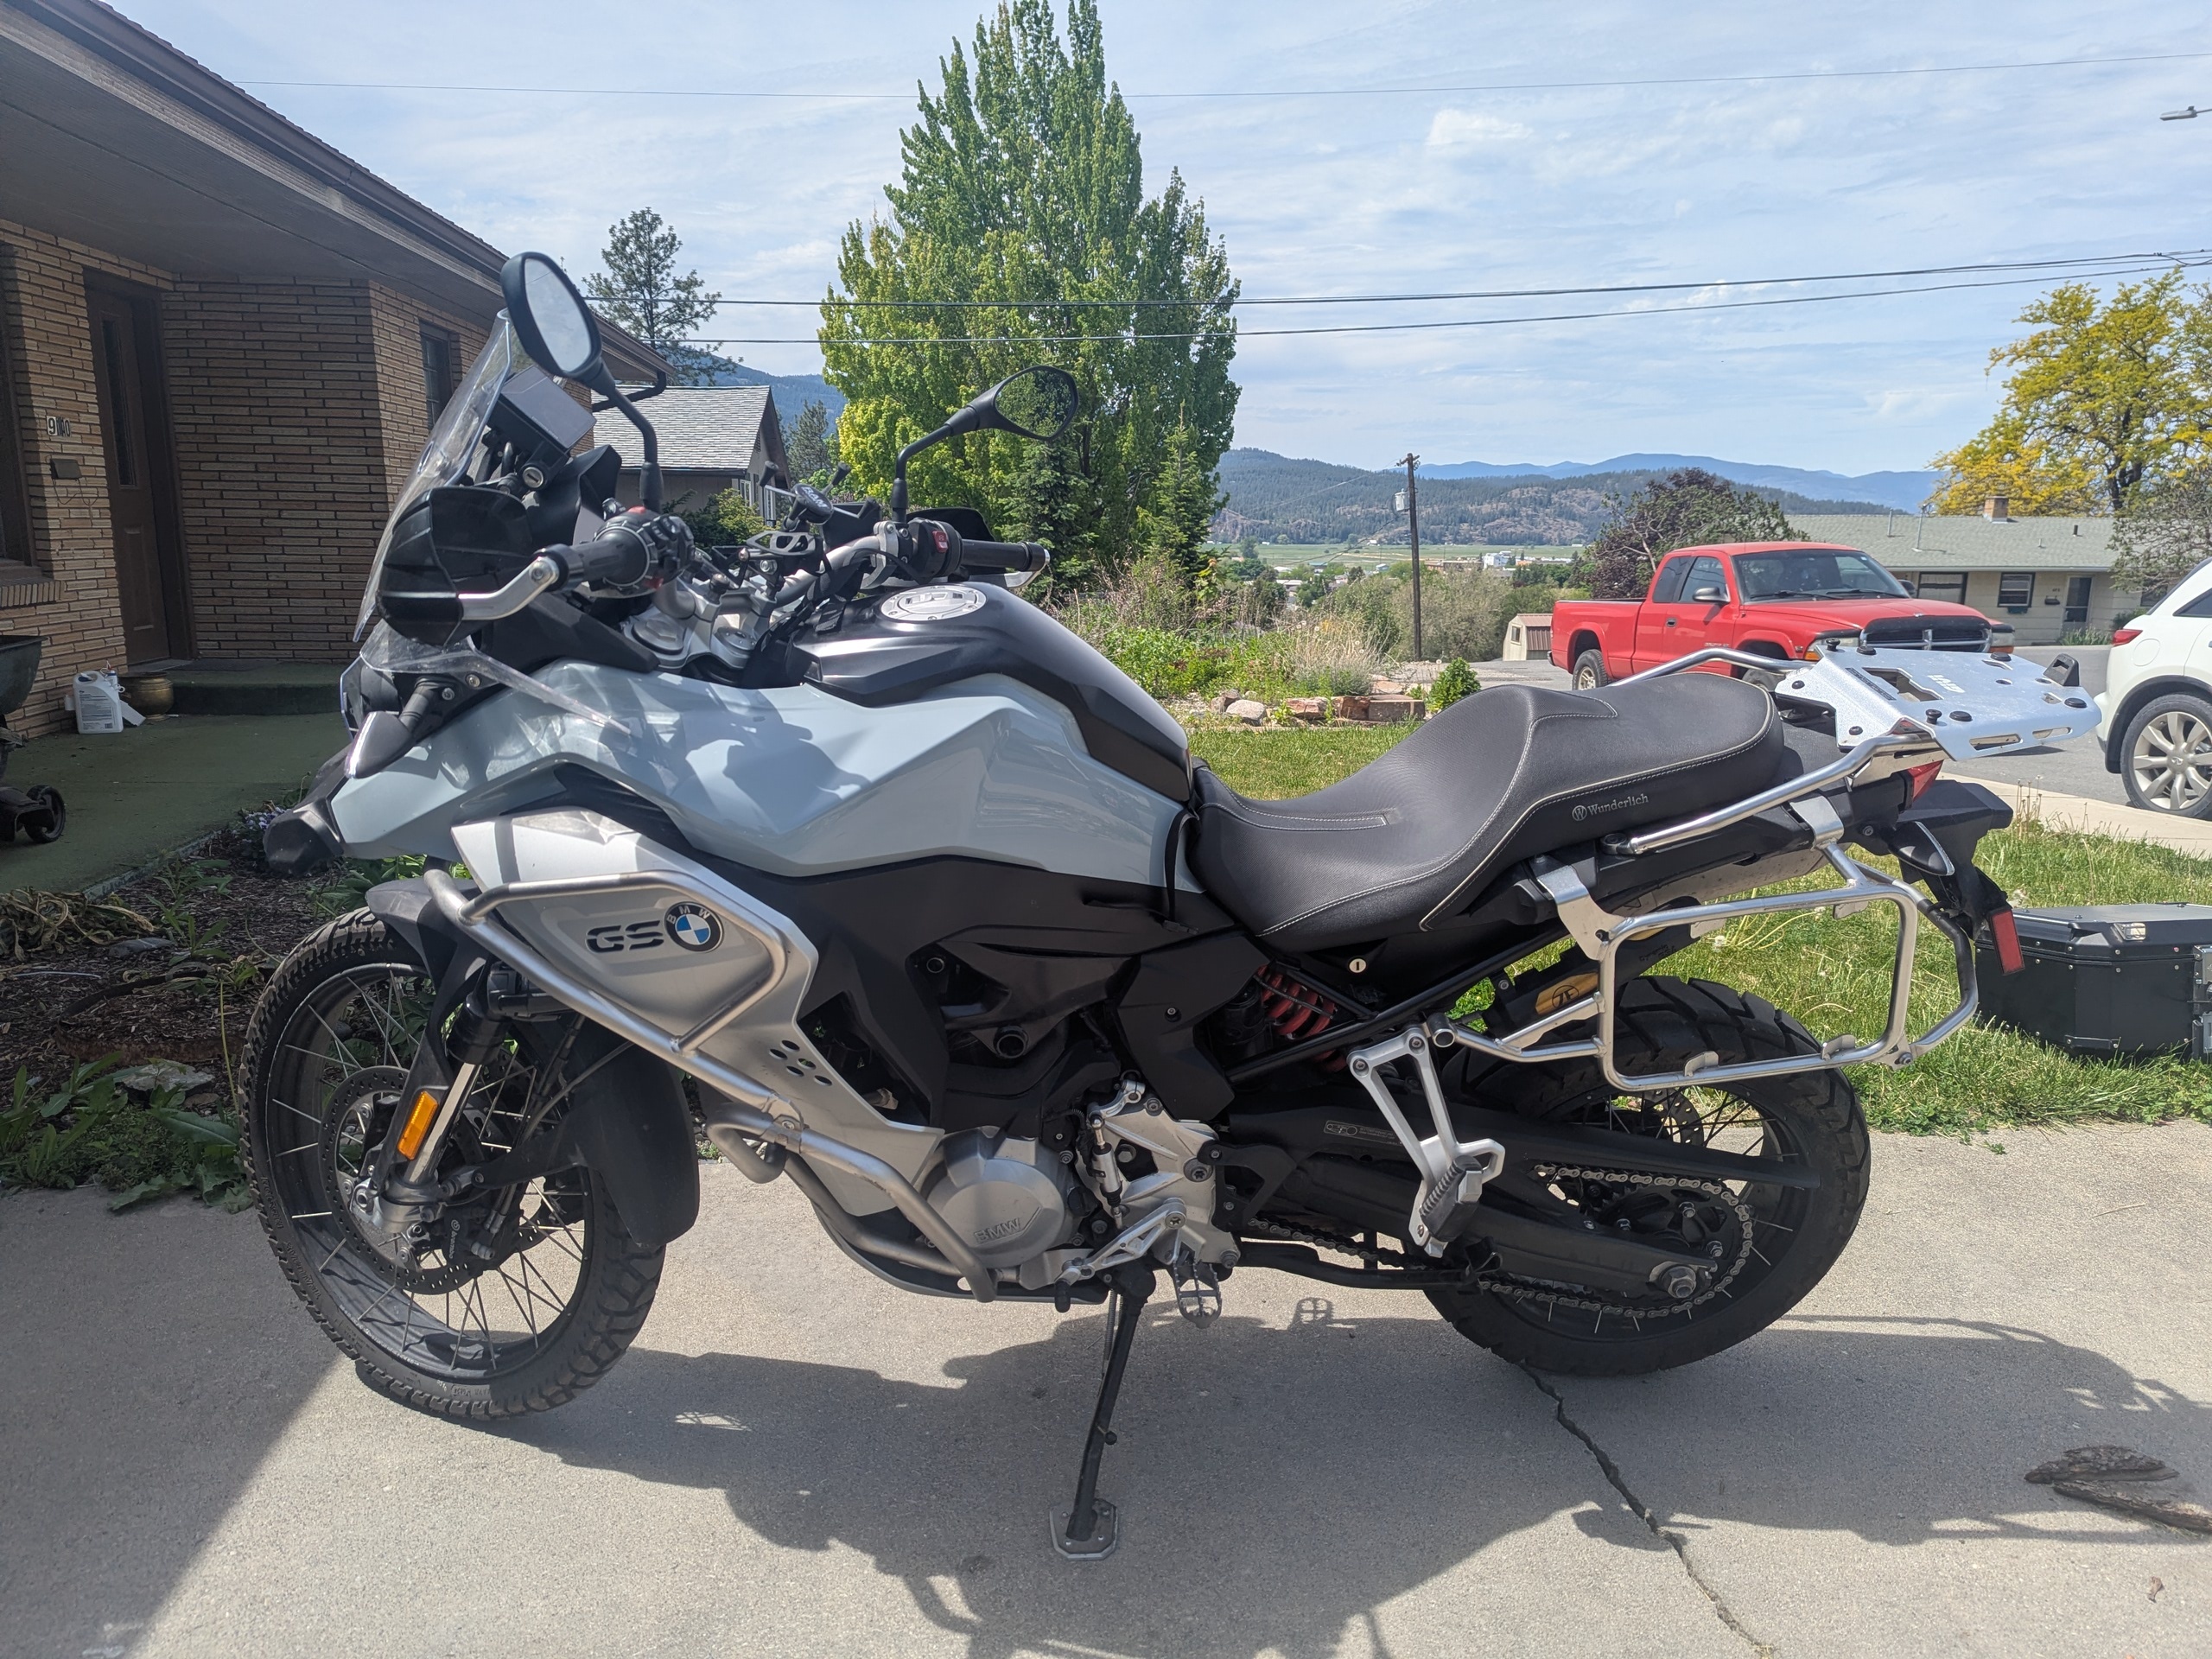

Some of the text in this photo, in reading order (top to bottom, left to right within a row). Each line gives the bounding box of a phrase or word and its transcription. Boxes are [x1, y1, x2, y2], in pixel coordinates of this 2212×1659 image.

[1587, 793, 1649, 816] Wunderlich
[586, 920, 664, 953] GS
[974, 1217, 1020, 1243] BMW
